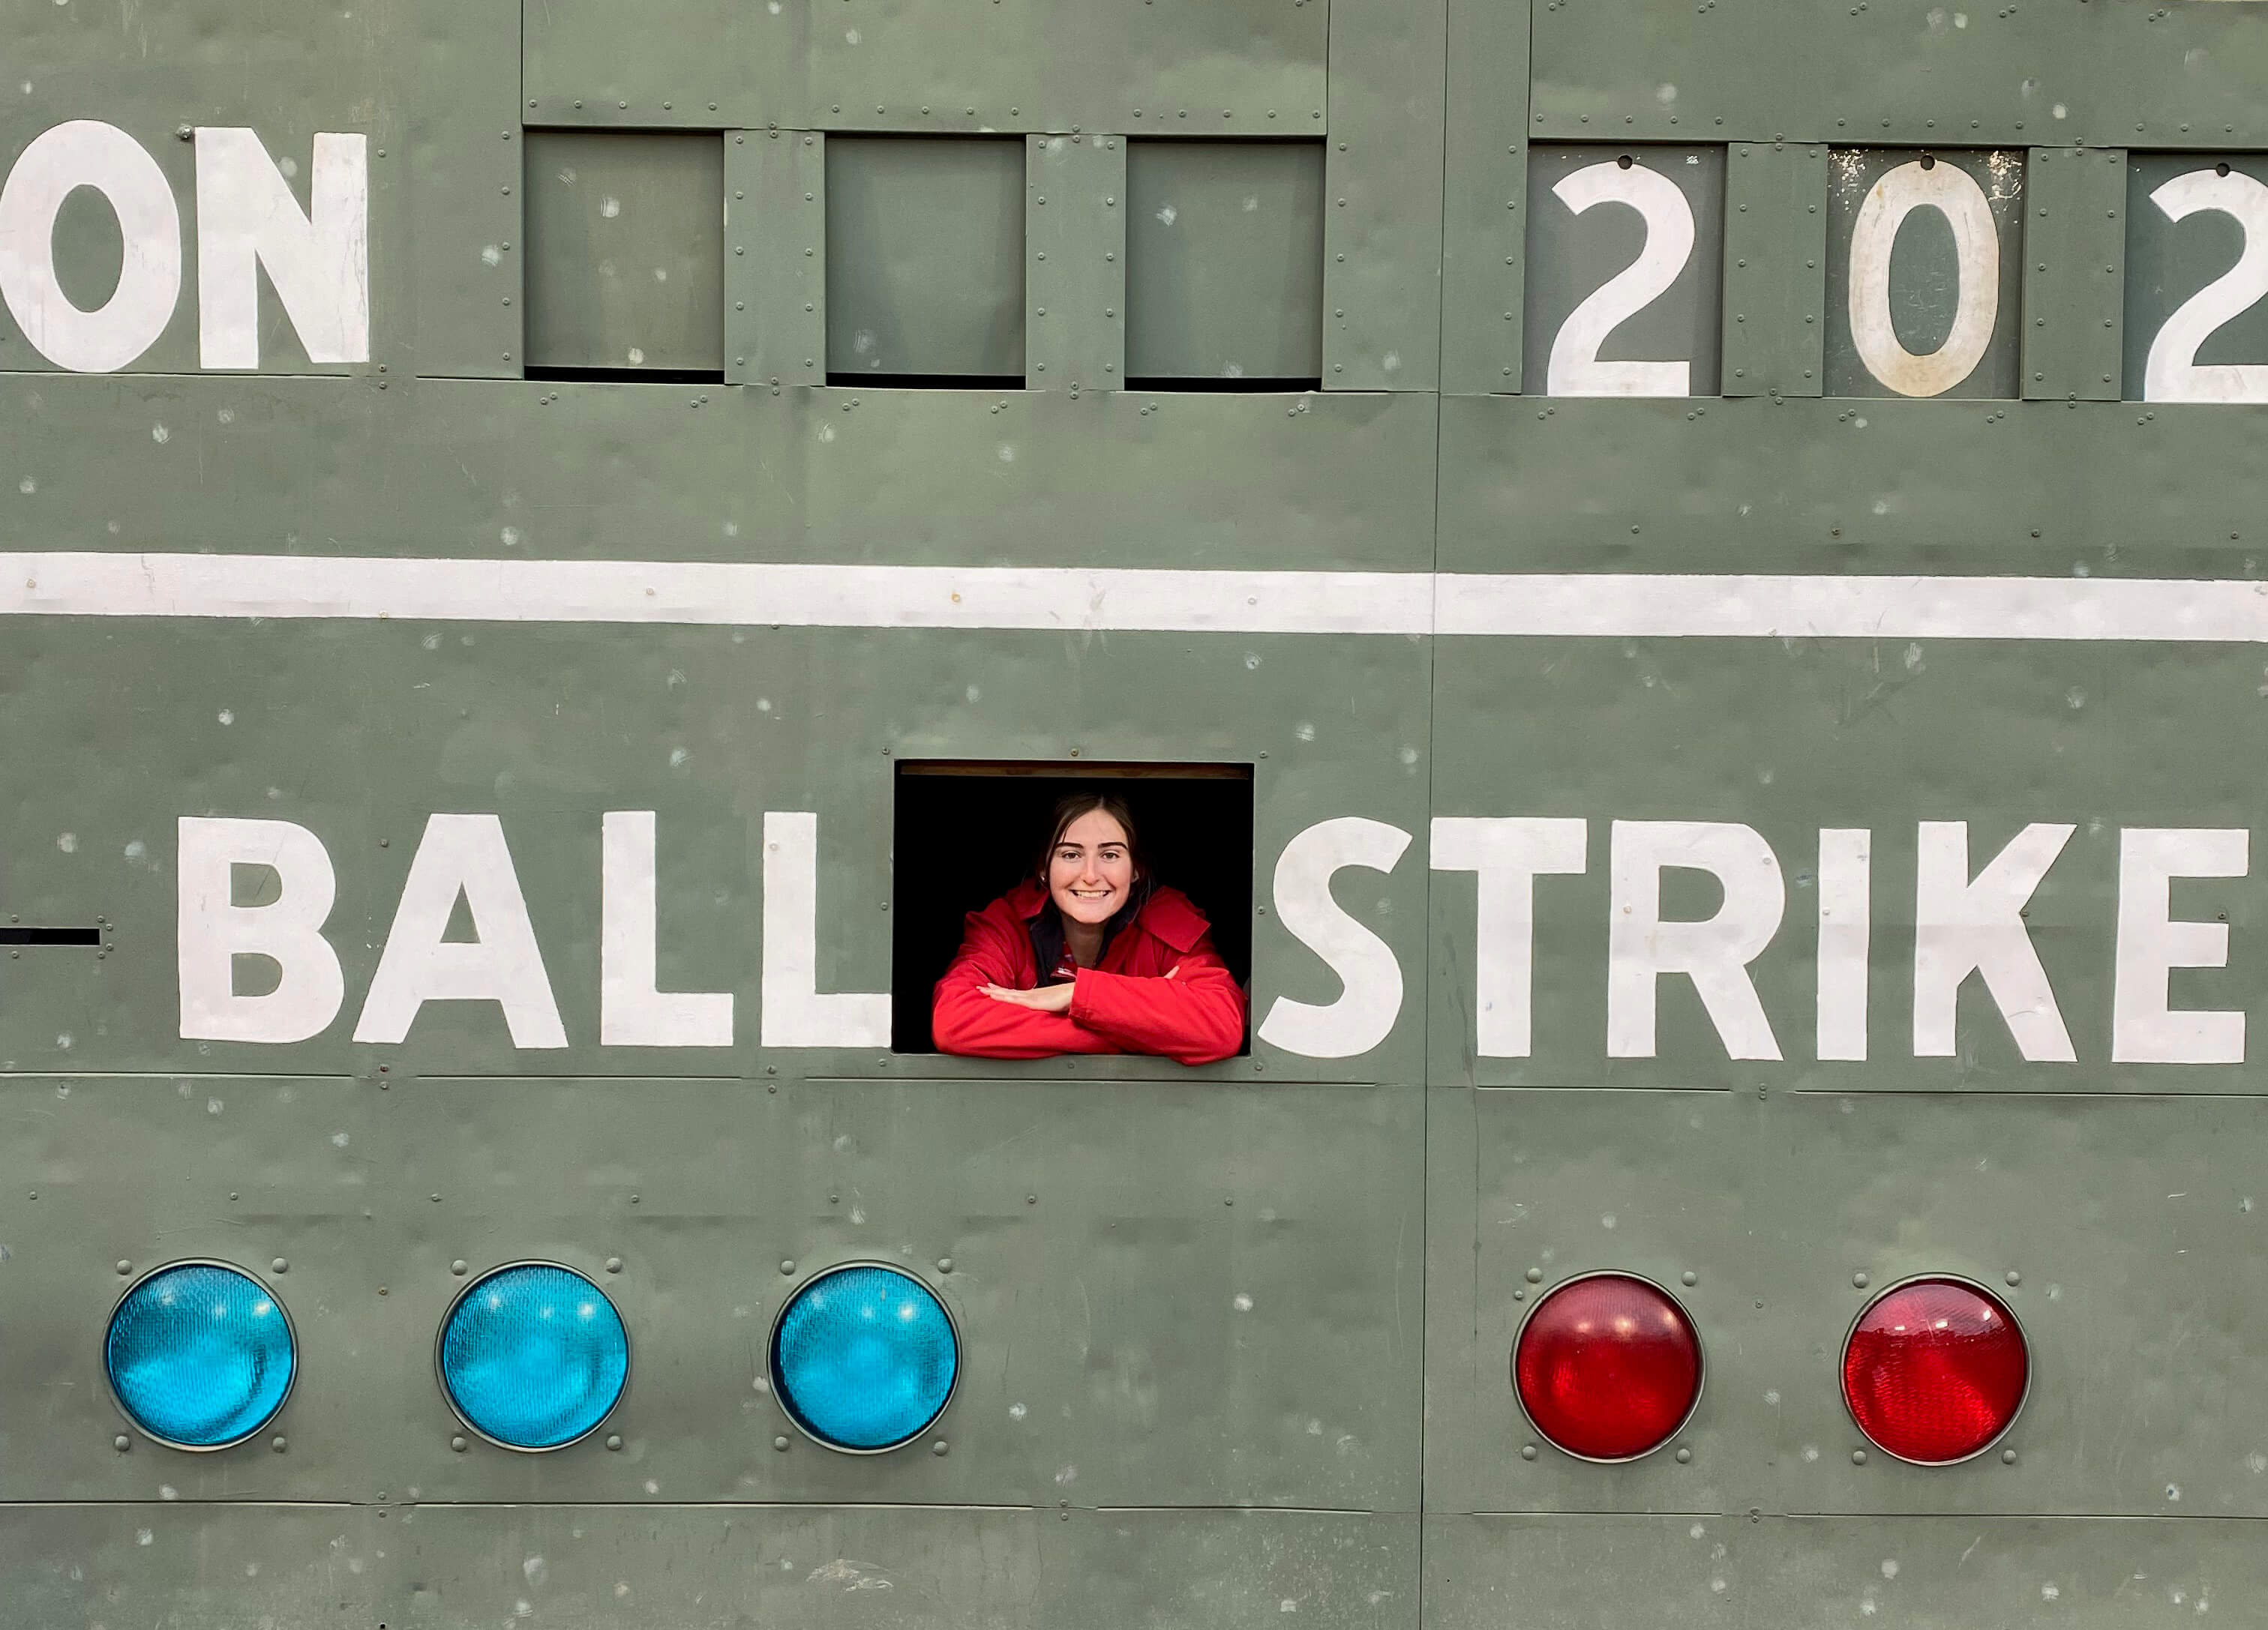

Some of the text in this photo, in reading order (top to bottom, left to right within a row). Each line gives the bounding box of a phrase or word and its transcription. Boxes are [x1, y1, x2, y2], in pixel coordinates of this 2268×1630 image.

[0, 120, 370, 373] ON
[178, 811, 892, 1049] BALL
[1258, 817, 2249, 1064] STRIKE
